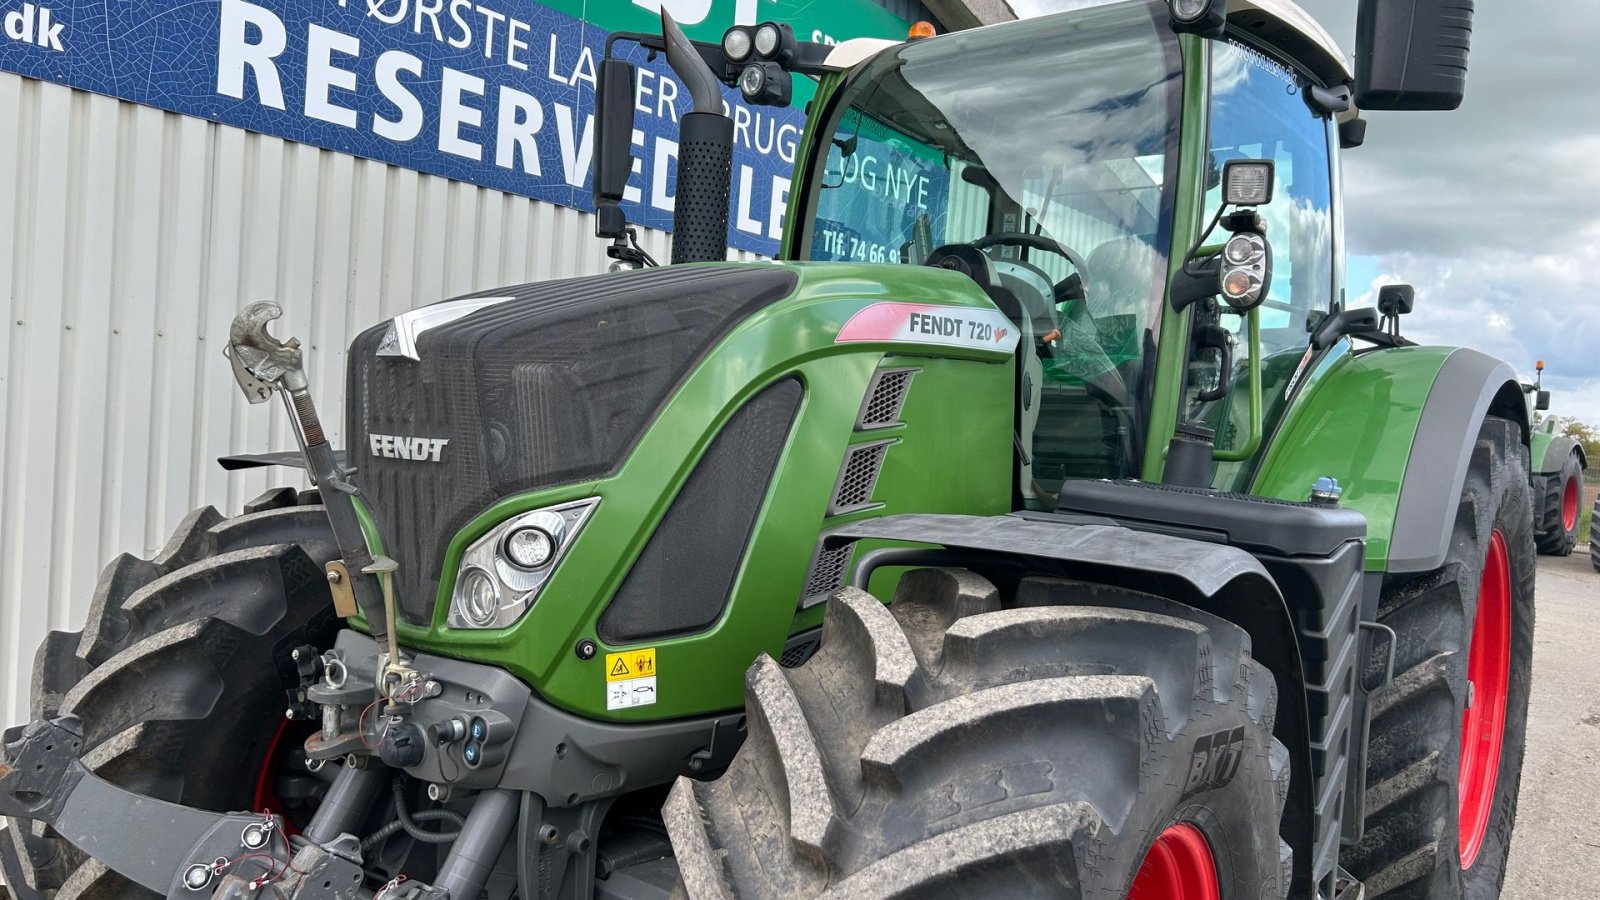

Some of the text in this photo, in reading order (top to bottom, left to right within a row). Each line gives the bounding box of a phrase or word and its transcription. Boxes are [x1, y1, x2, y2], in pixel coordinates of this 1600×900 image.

[4, 3, 65, 52] dk
[548, 33, 678, 123] LAER
[840, 151, 877, 191] OG
[885, 163, 930, 210] NYE
[823, 229, 846, 256] Tlf.
[850, 237, 866, 262] 74
[869, 243, 886, 264] 66
[910, 312, 963, 338] FENDT
[968, 321, 992, 341] 720
[369, 433, 450, 462] FENDT
[1183, 732, 1244, 796] BKT
